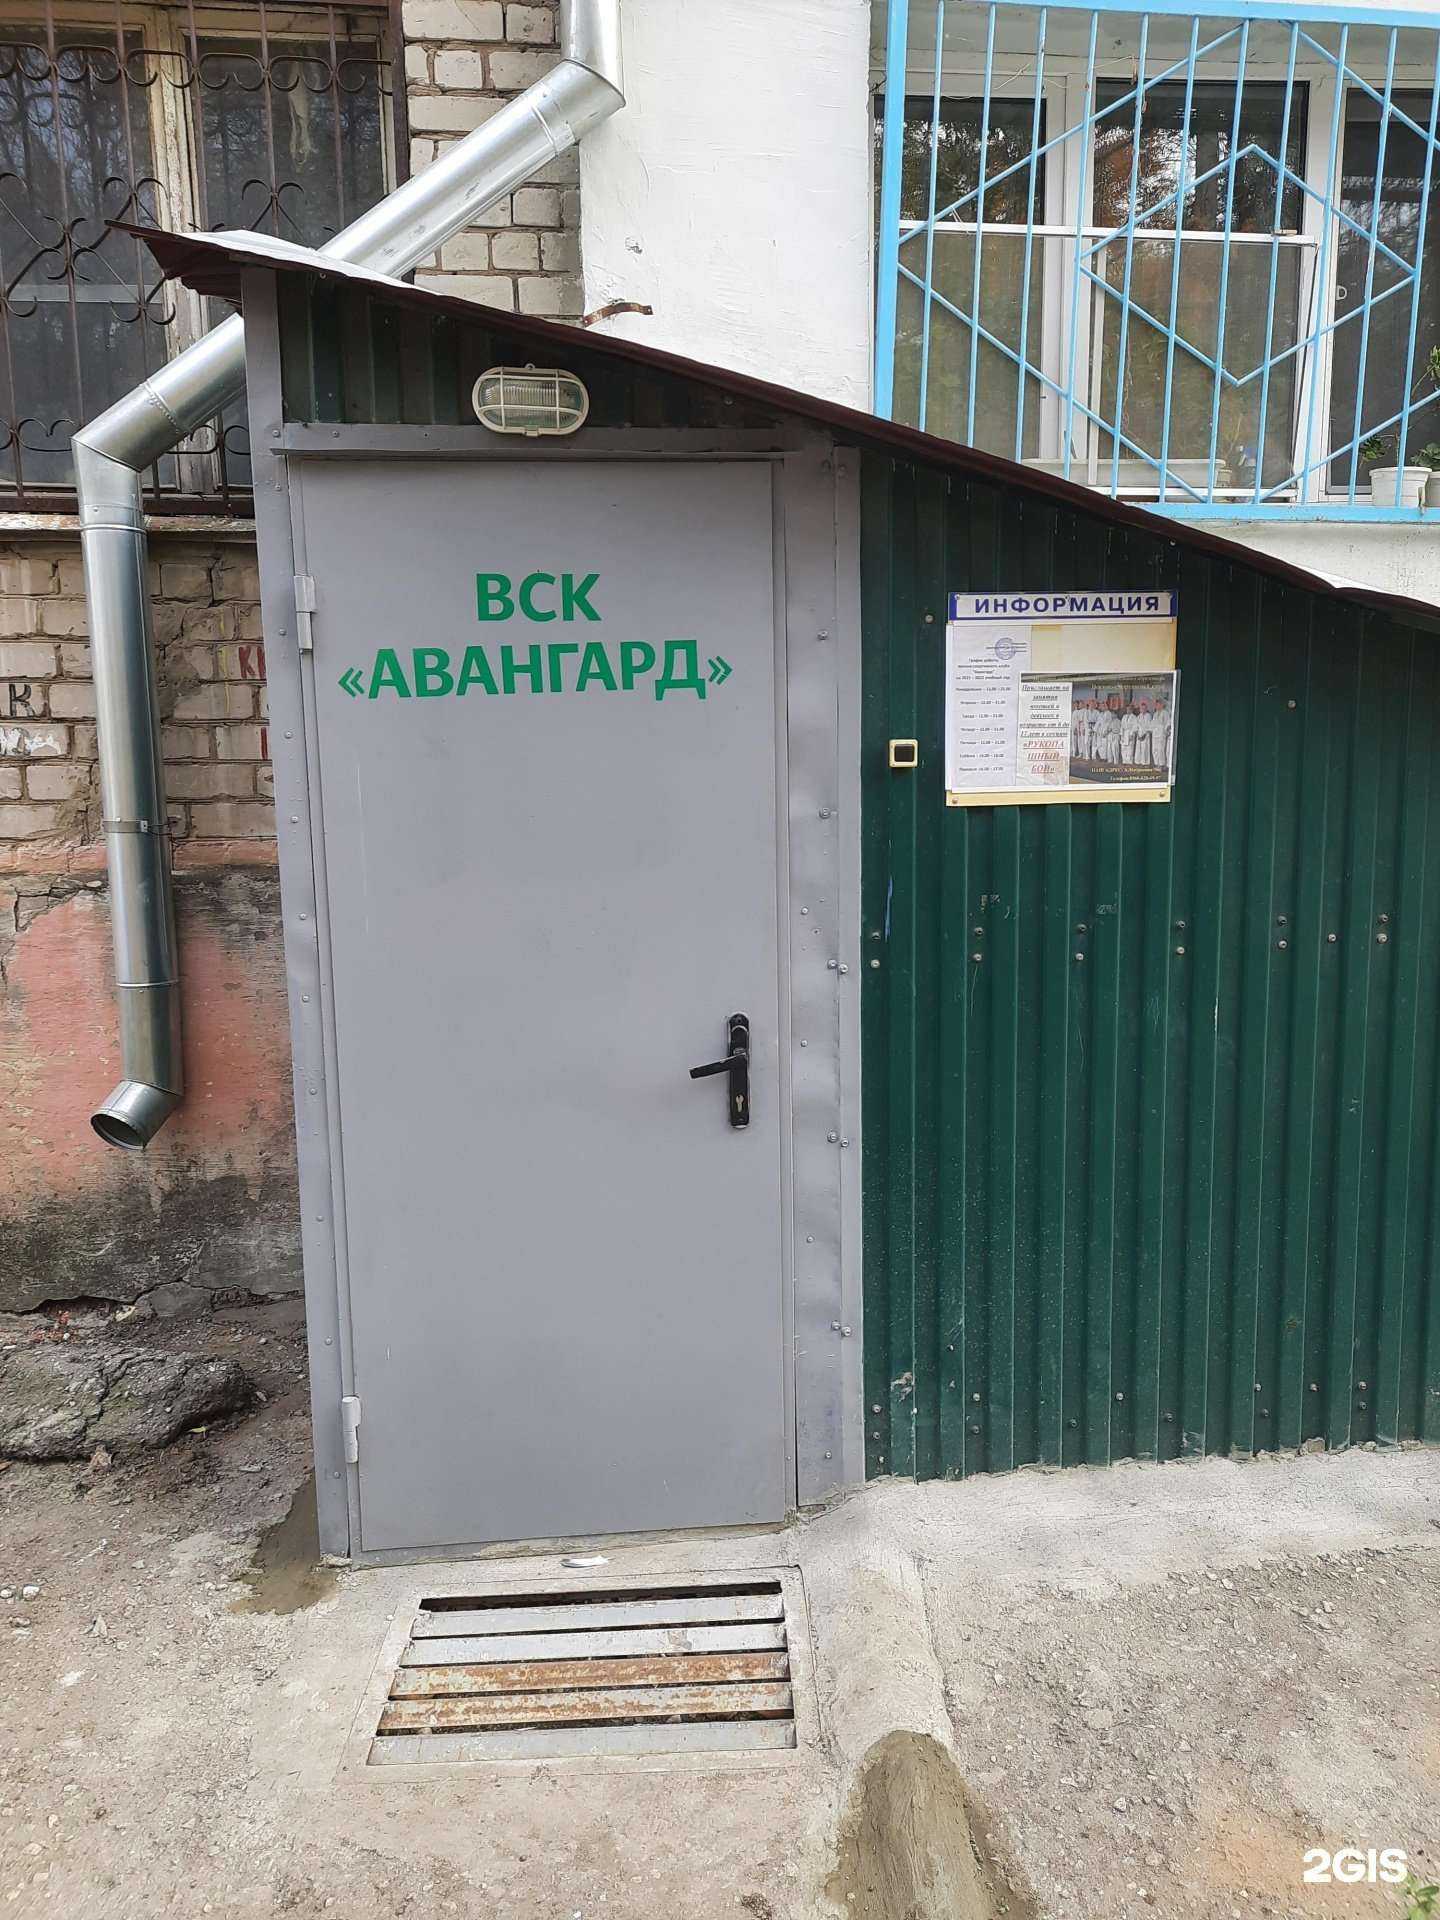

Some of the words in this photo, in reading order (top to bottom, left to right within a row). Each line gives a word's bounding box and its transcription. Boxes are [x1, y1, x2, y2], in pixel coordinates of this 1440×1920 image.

[476, 572, 601, 622] ВСК
[975, 596, 1159, 614] ИНФОРМАЦИЯ
[338, 640, 733, 701] «АВАНГАРД»
